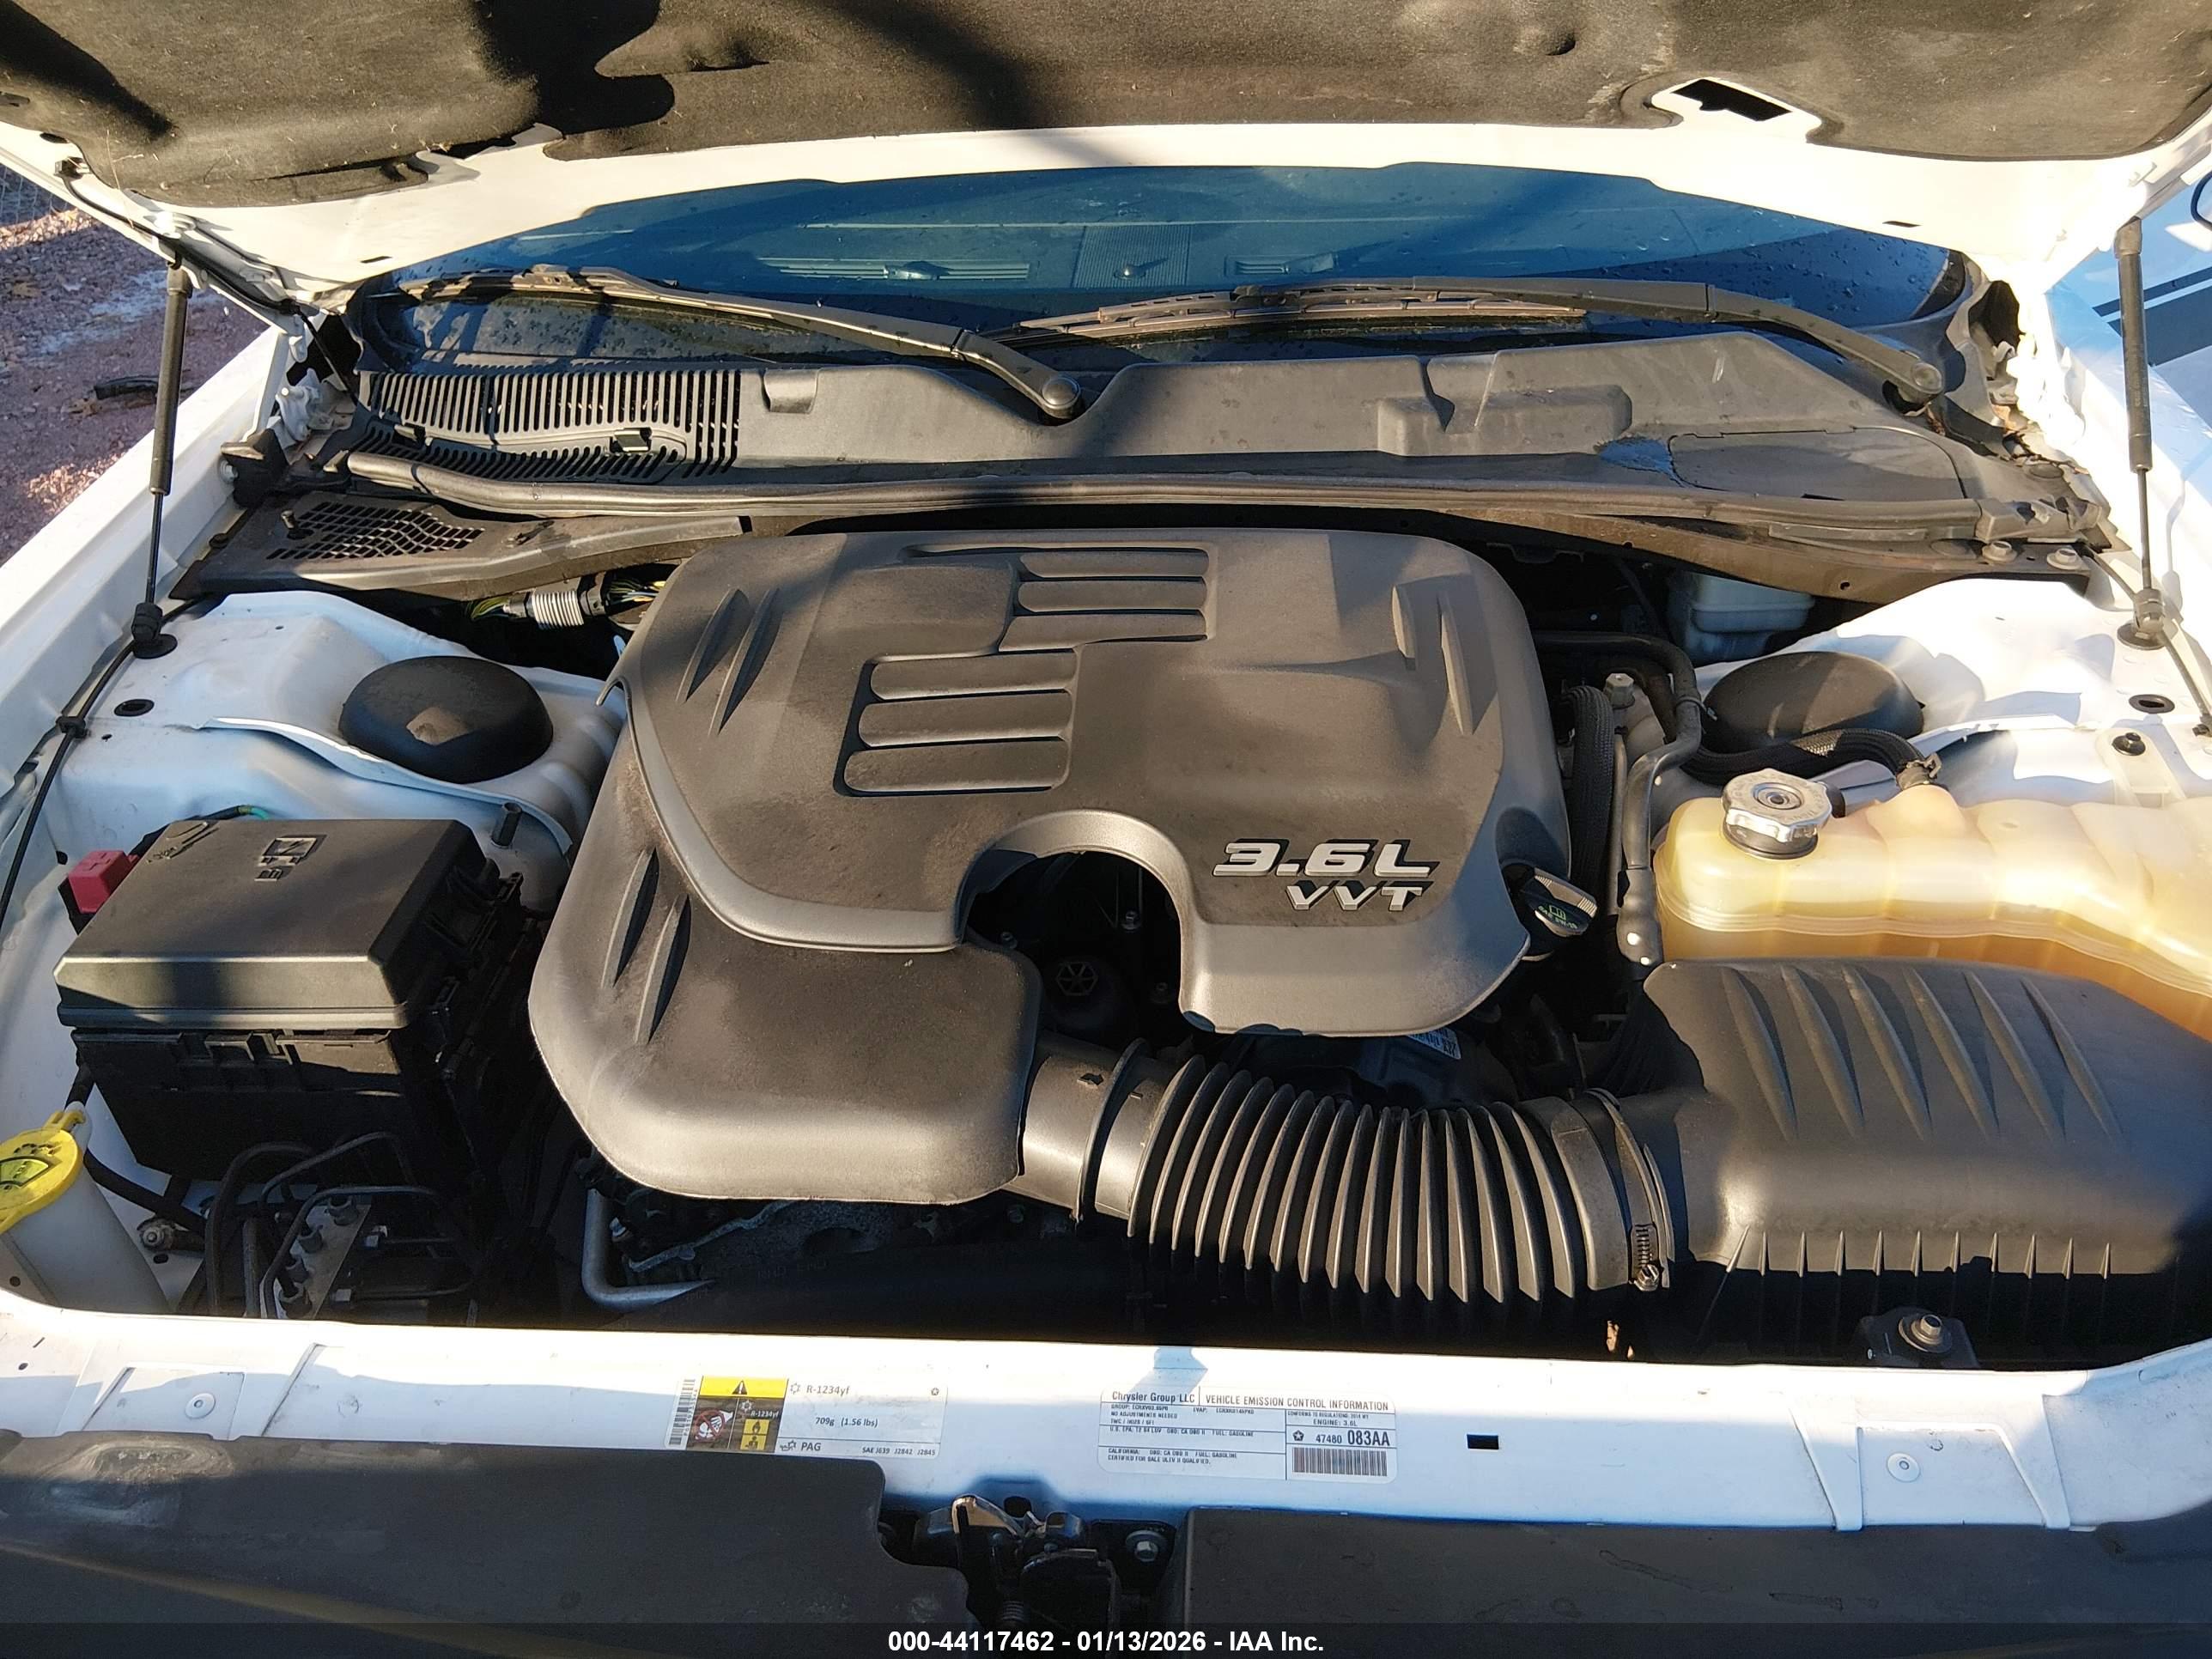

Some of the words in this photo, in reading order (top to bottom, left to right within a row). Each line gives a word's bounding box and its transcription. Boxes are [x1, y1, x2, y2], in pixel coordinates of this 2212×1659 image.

[1212, 842, 1432, 877] 3.6L
[1285, 884, 1424, 912] VVT
[806, 1384, 850, 1397] R-1234yf
[1112, 1391, 1146, 1402] Chrysler
[1151, 1392, 1176, 1405] Group
[1179, 1394, 1195, 1403] LLC
[1206, 1395, 1240, 1405] VEHICLE
[1244, 1396, 1284, 1407] EMISSION
[1288, 1398, 1326, 1408] CONTROL
[1330, 1401, 1389, 1411] INFORMATION
[816, 1417, 834, 1426] 709g
[841, 1417, 861, 1427] (1.56
[863, 1418, 878, 1428] lbs)
[1316, 1434, 1342, 1443] 47480
[1347, 1430, 1390, 1446] 083AA
[800, 1442, 821, 1451] PAG
